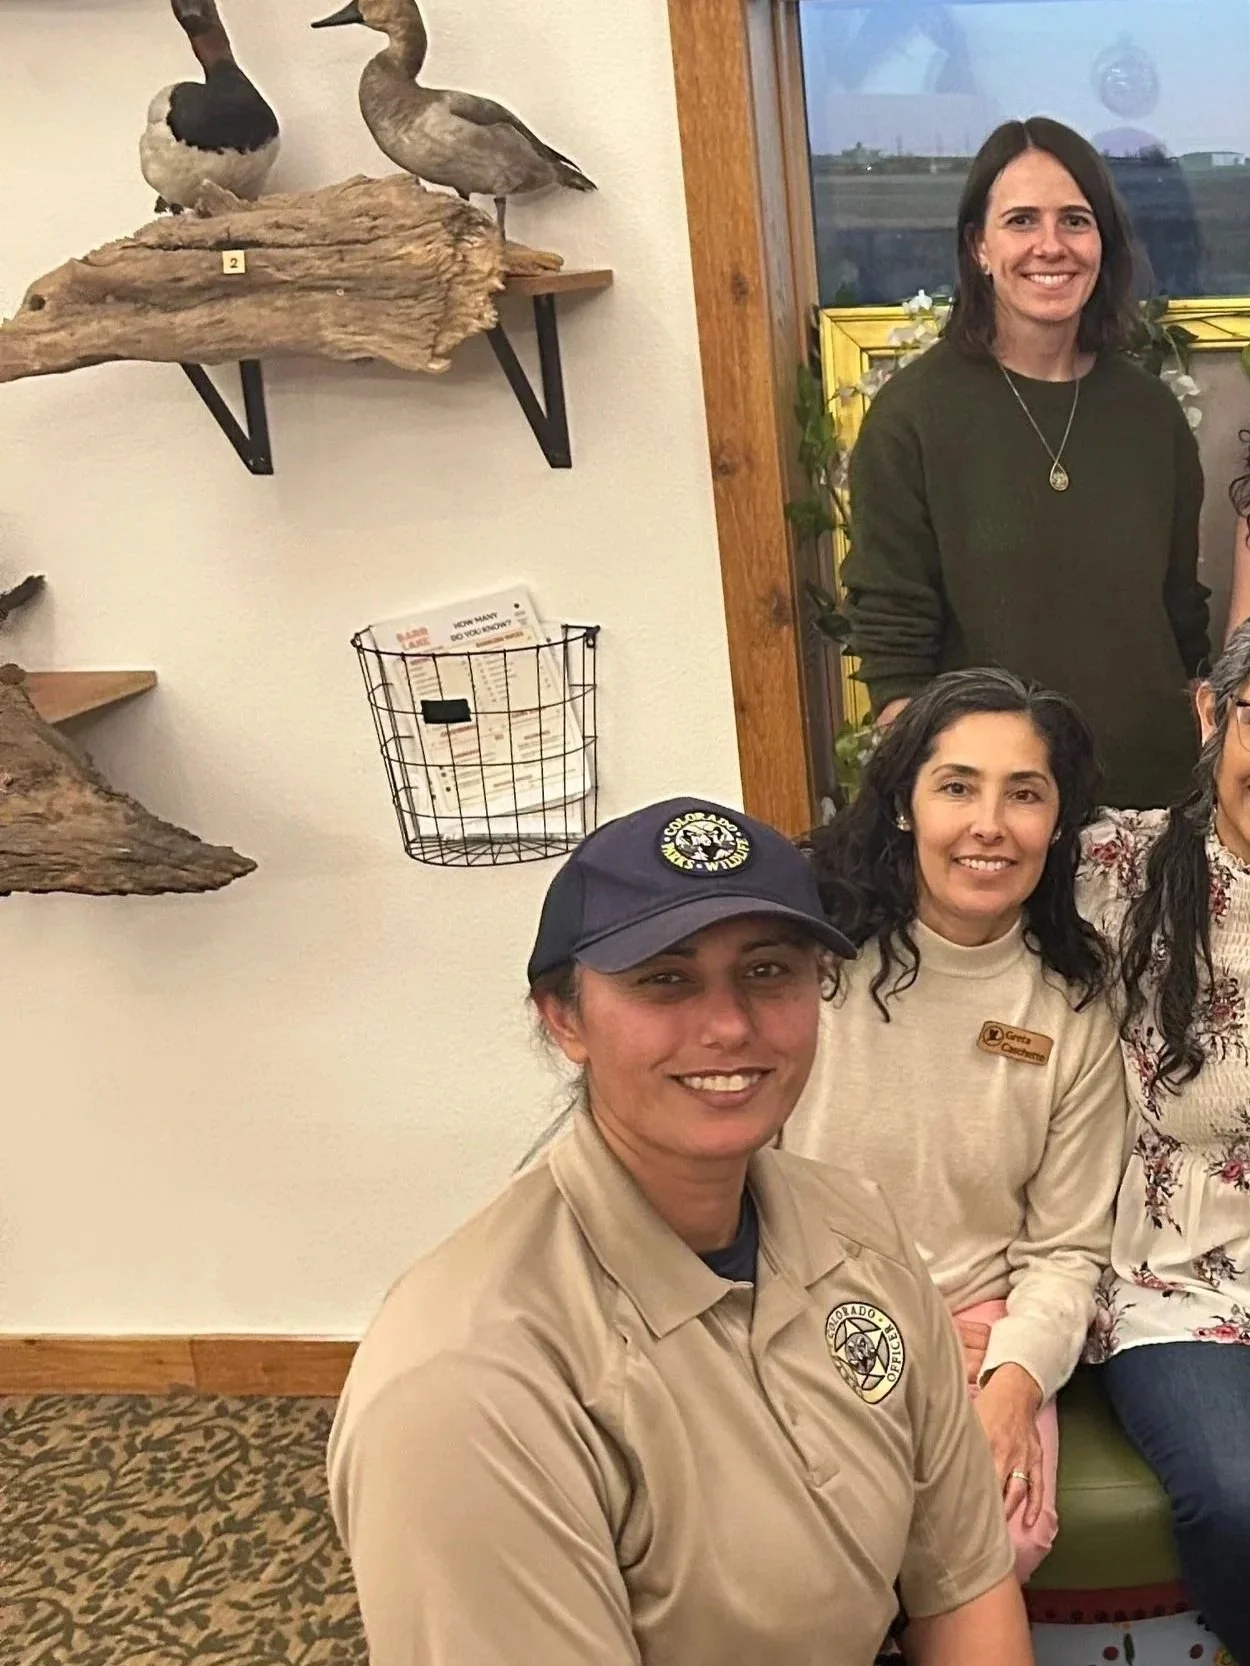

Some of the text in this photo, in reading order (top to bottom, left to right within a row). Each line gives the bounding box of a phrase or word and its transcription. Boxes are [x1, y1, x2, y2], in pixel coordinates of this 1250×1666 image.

[229, 257, 239, 269] 2
[450, 632, 464, 642] DO
[464, 627, 482, 638] YOU
[482, 618, 512, 633] KNOW?
[453, 612, 498, 629] HOW MANY
[663, 812, 738, 837] COLORADO
[661, 842, 696, 870] PARKS
[1005, 1030, 1032, 1045] Greta
[827, 1305, 876, 1339] COLORADO
[884, 1323, 902, 1382] OFFICER
